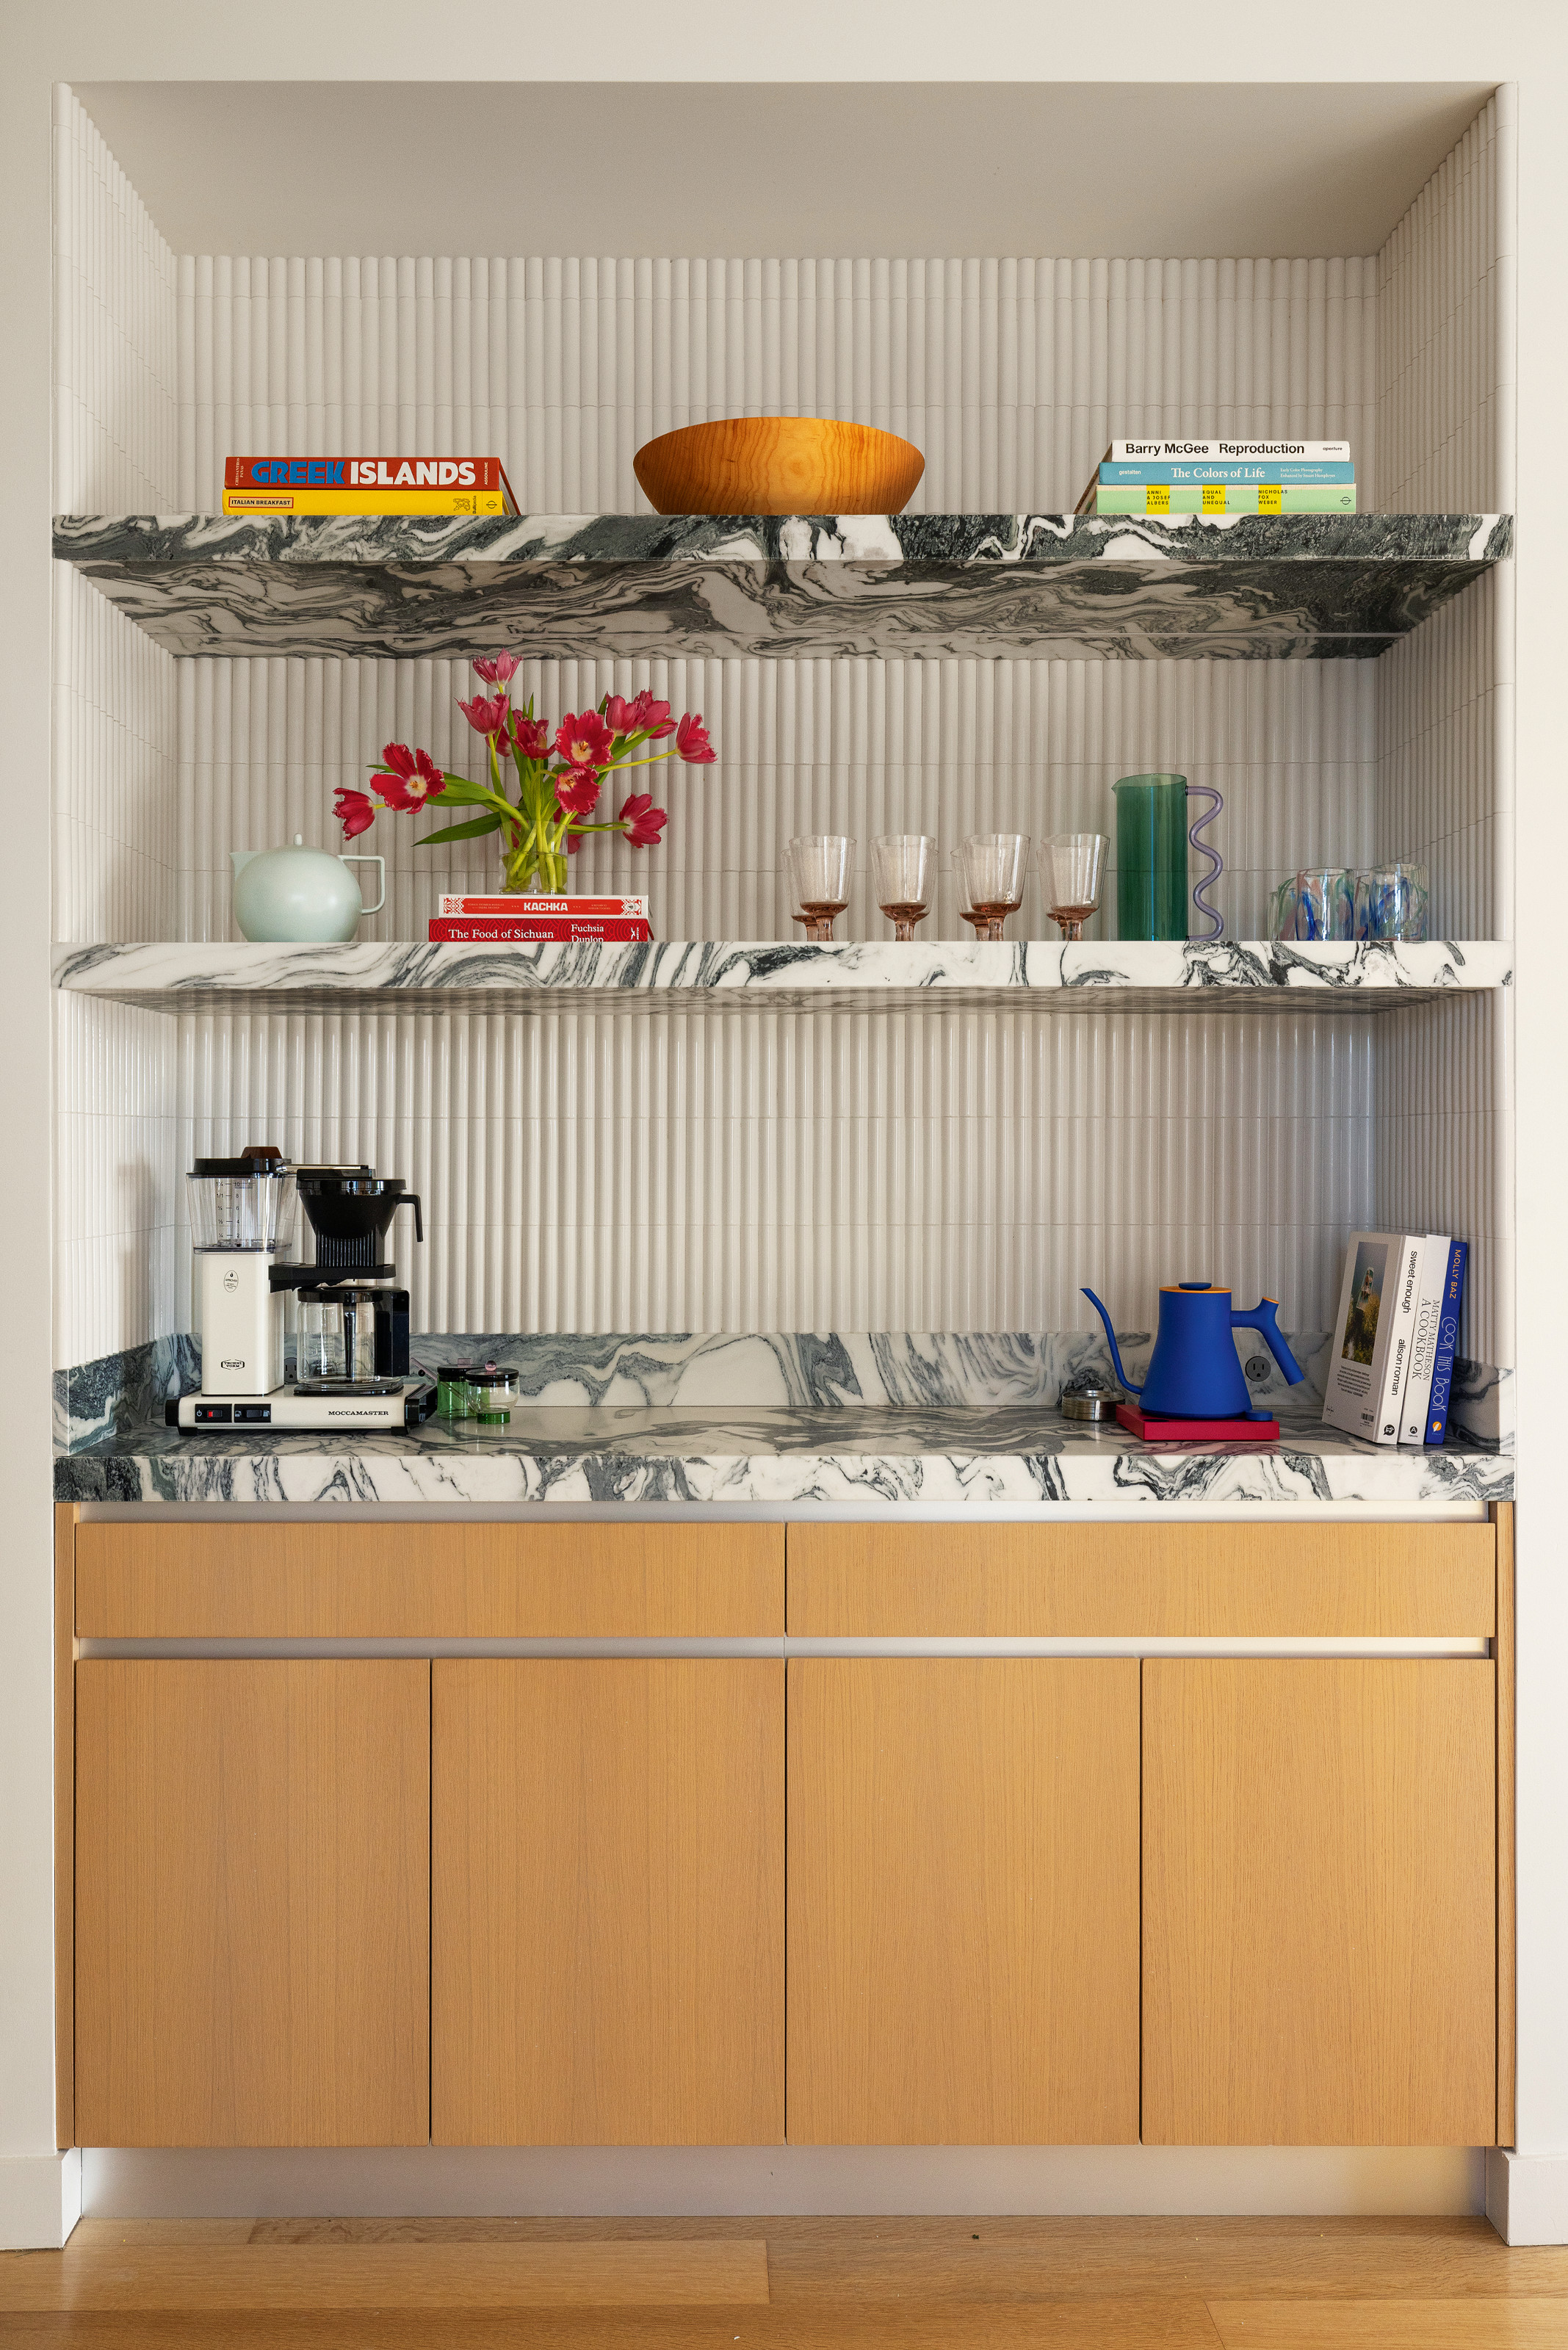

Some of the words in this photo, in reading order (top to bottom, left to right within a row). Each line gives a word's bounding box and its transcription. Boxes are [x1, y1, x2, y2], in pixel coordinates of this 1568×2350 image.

[1125, 444, 1160, 457] Barry
[1164, 443, 1209, 454] McGee
[1219, 443, 1304, 457] Reproduction
[251, 461, 345, 484] GREEK
[350, 461, 476, 485] ISLANDS
[1171, 468, 1191, 478] The
[1193, 467, 1228, 478] Colors
[1230, 467, 1243, 478] of
[1244, 467, 1265, 478] Life
[524, 902, 568, 911] KACHKA
[448, 929, 469, 939] The
[472, 929, 498, 939] Food
[501, 929, 511, 939] of
[514, 929, 554, 939] Sichuan
[571, 924, 604, 932] Fuchsia
[1407, 1251, 1417, 1278] sweet
[1452, 1249, 1462, 1279] MOLLY
[1403, 1279, 1414, 1314] enough
[1422, 1298, 1431, 1307] A
[1450, 1282, 1458, 1299] BAZ
[1430, 1300, 1439, 1331] MATTY
[1412, 1310, 1431, 1379] COOKBOOK
[1439, 1317, 1457, 1351] COOK
[1395, 1339, 1404, 1366] alison
[1423, 1331, 1437, 1381] MATHESON
[1437, 1356, 1452, 1372] THIS
[1391, 1366, 1401, 1396] roman
[1432, 1377, 1450, 1411] BOOK
